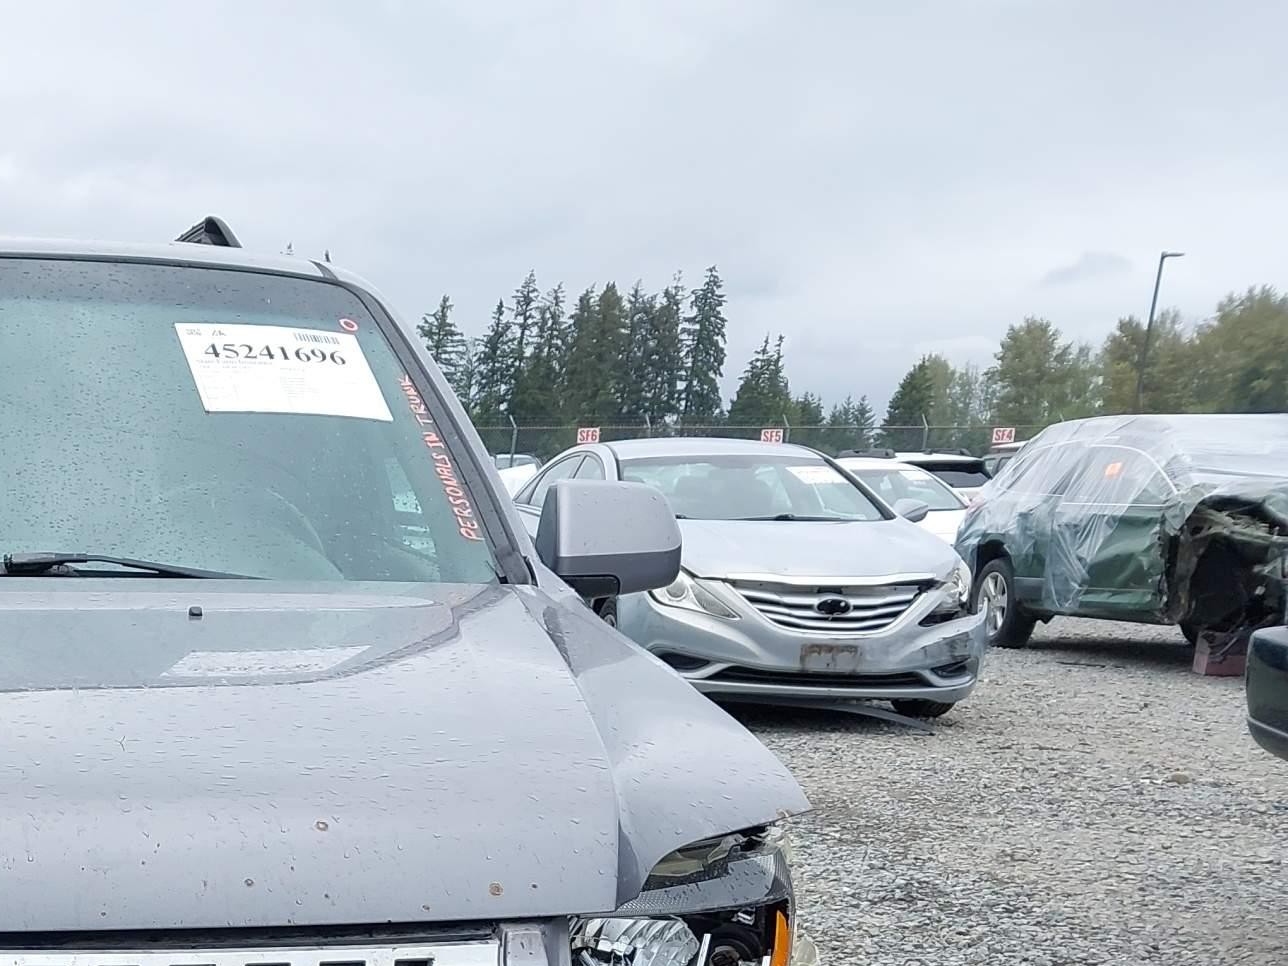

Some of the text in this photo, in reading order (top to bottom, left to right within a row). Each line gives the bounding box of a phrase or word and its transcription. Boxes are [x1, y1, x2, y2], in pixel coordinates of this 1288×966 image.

[204, 342, 347, 367] 45241696
[579, 429, 598, 442] SF6
[763, 430, 782, 442] SF5
[994, 429, 1014, 441] SF4
[399, 374, 485, 541] PERSONALS IN TRUNK
